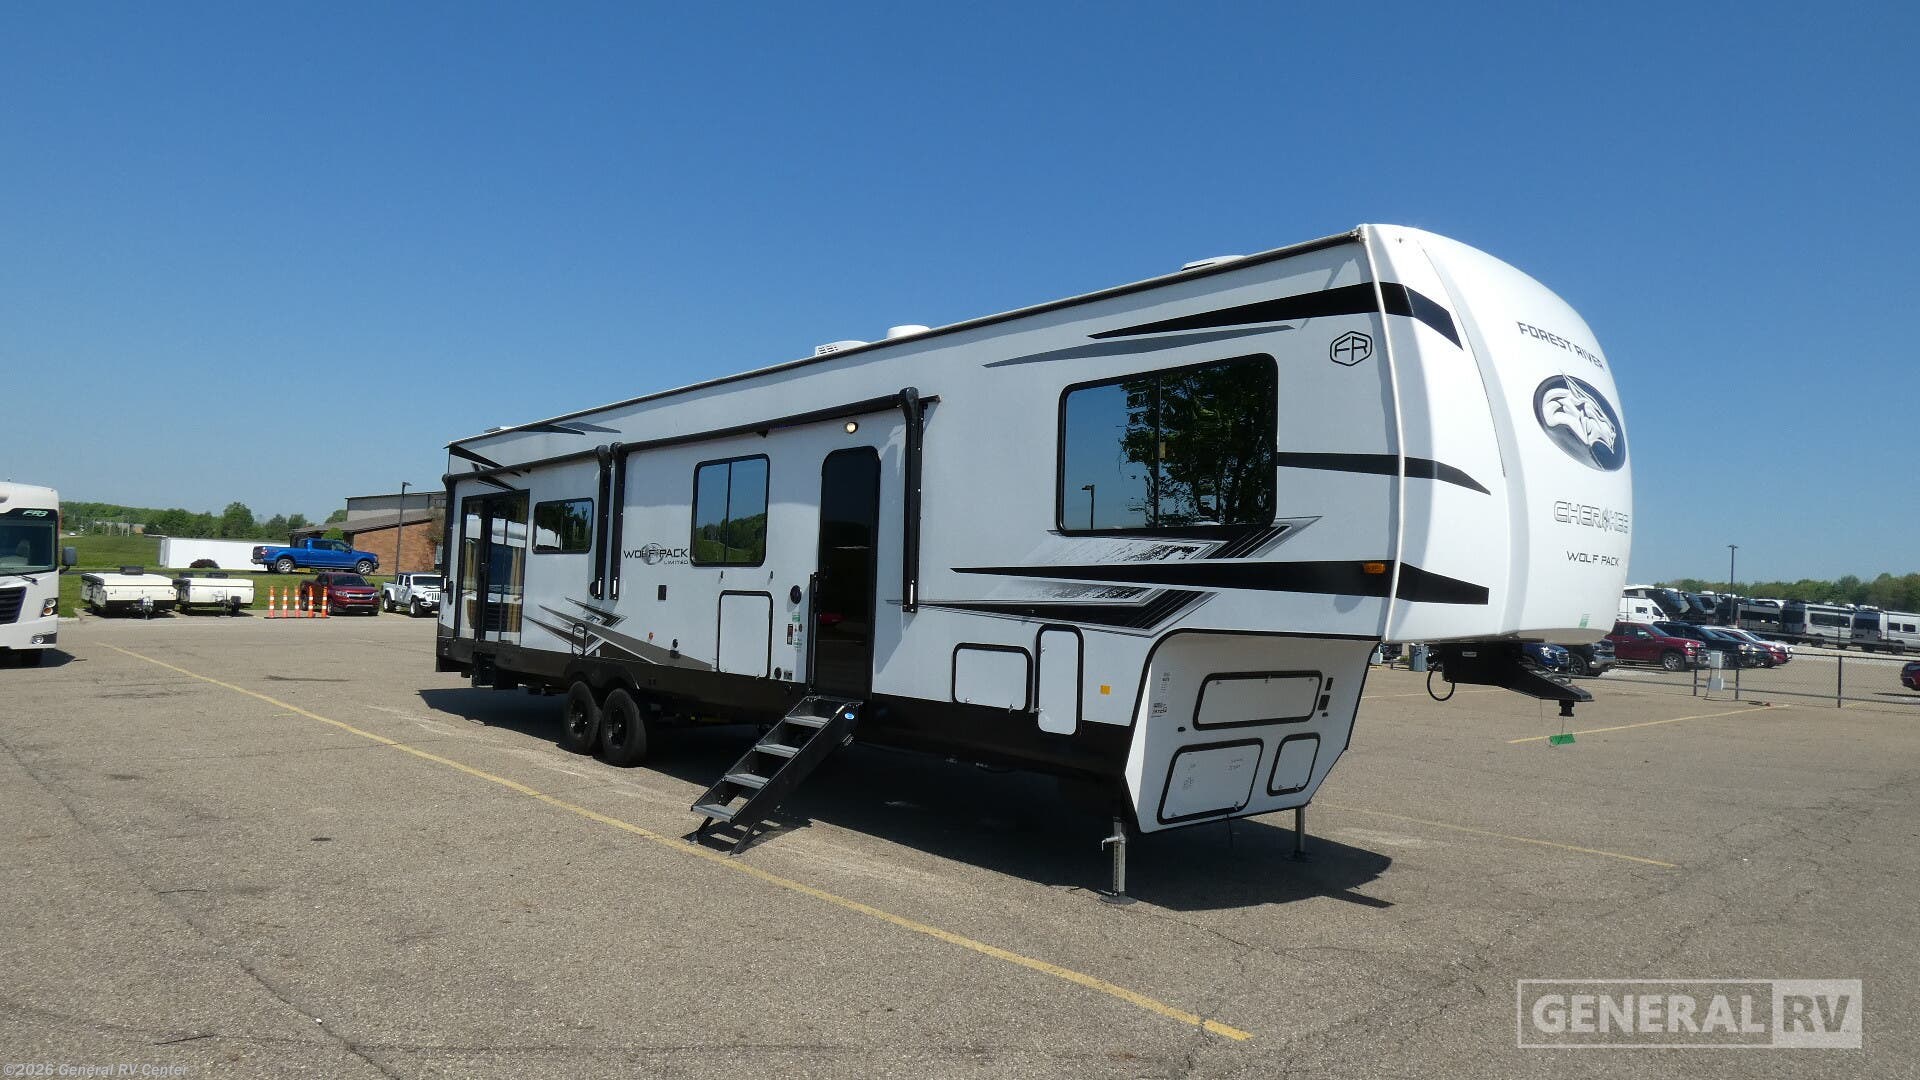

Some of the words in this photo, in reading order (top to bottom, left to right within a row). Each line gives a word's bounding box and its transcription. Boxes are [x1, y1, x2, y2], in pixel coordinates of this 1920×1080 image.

[1334, 335, 1368, 361] FR
[1516, 321, 1573, 352] FOREST
[1573, 343, 1604, 371] RIVER
[623, 549, 656, 559] WOLF
[659, 548, 689, 558] PACK
[1566, 550, 1599, 563] WOLF
[1601, 555, 1619, 566] PACK
